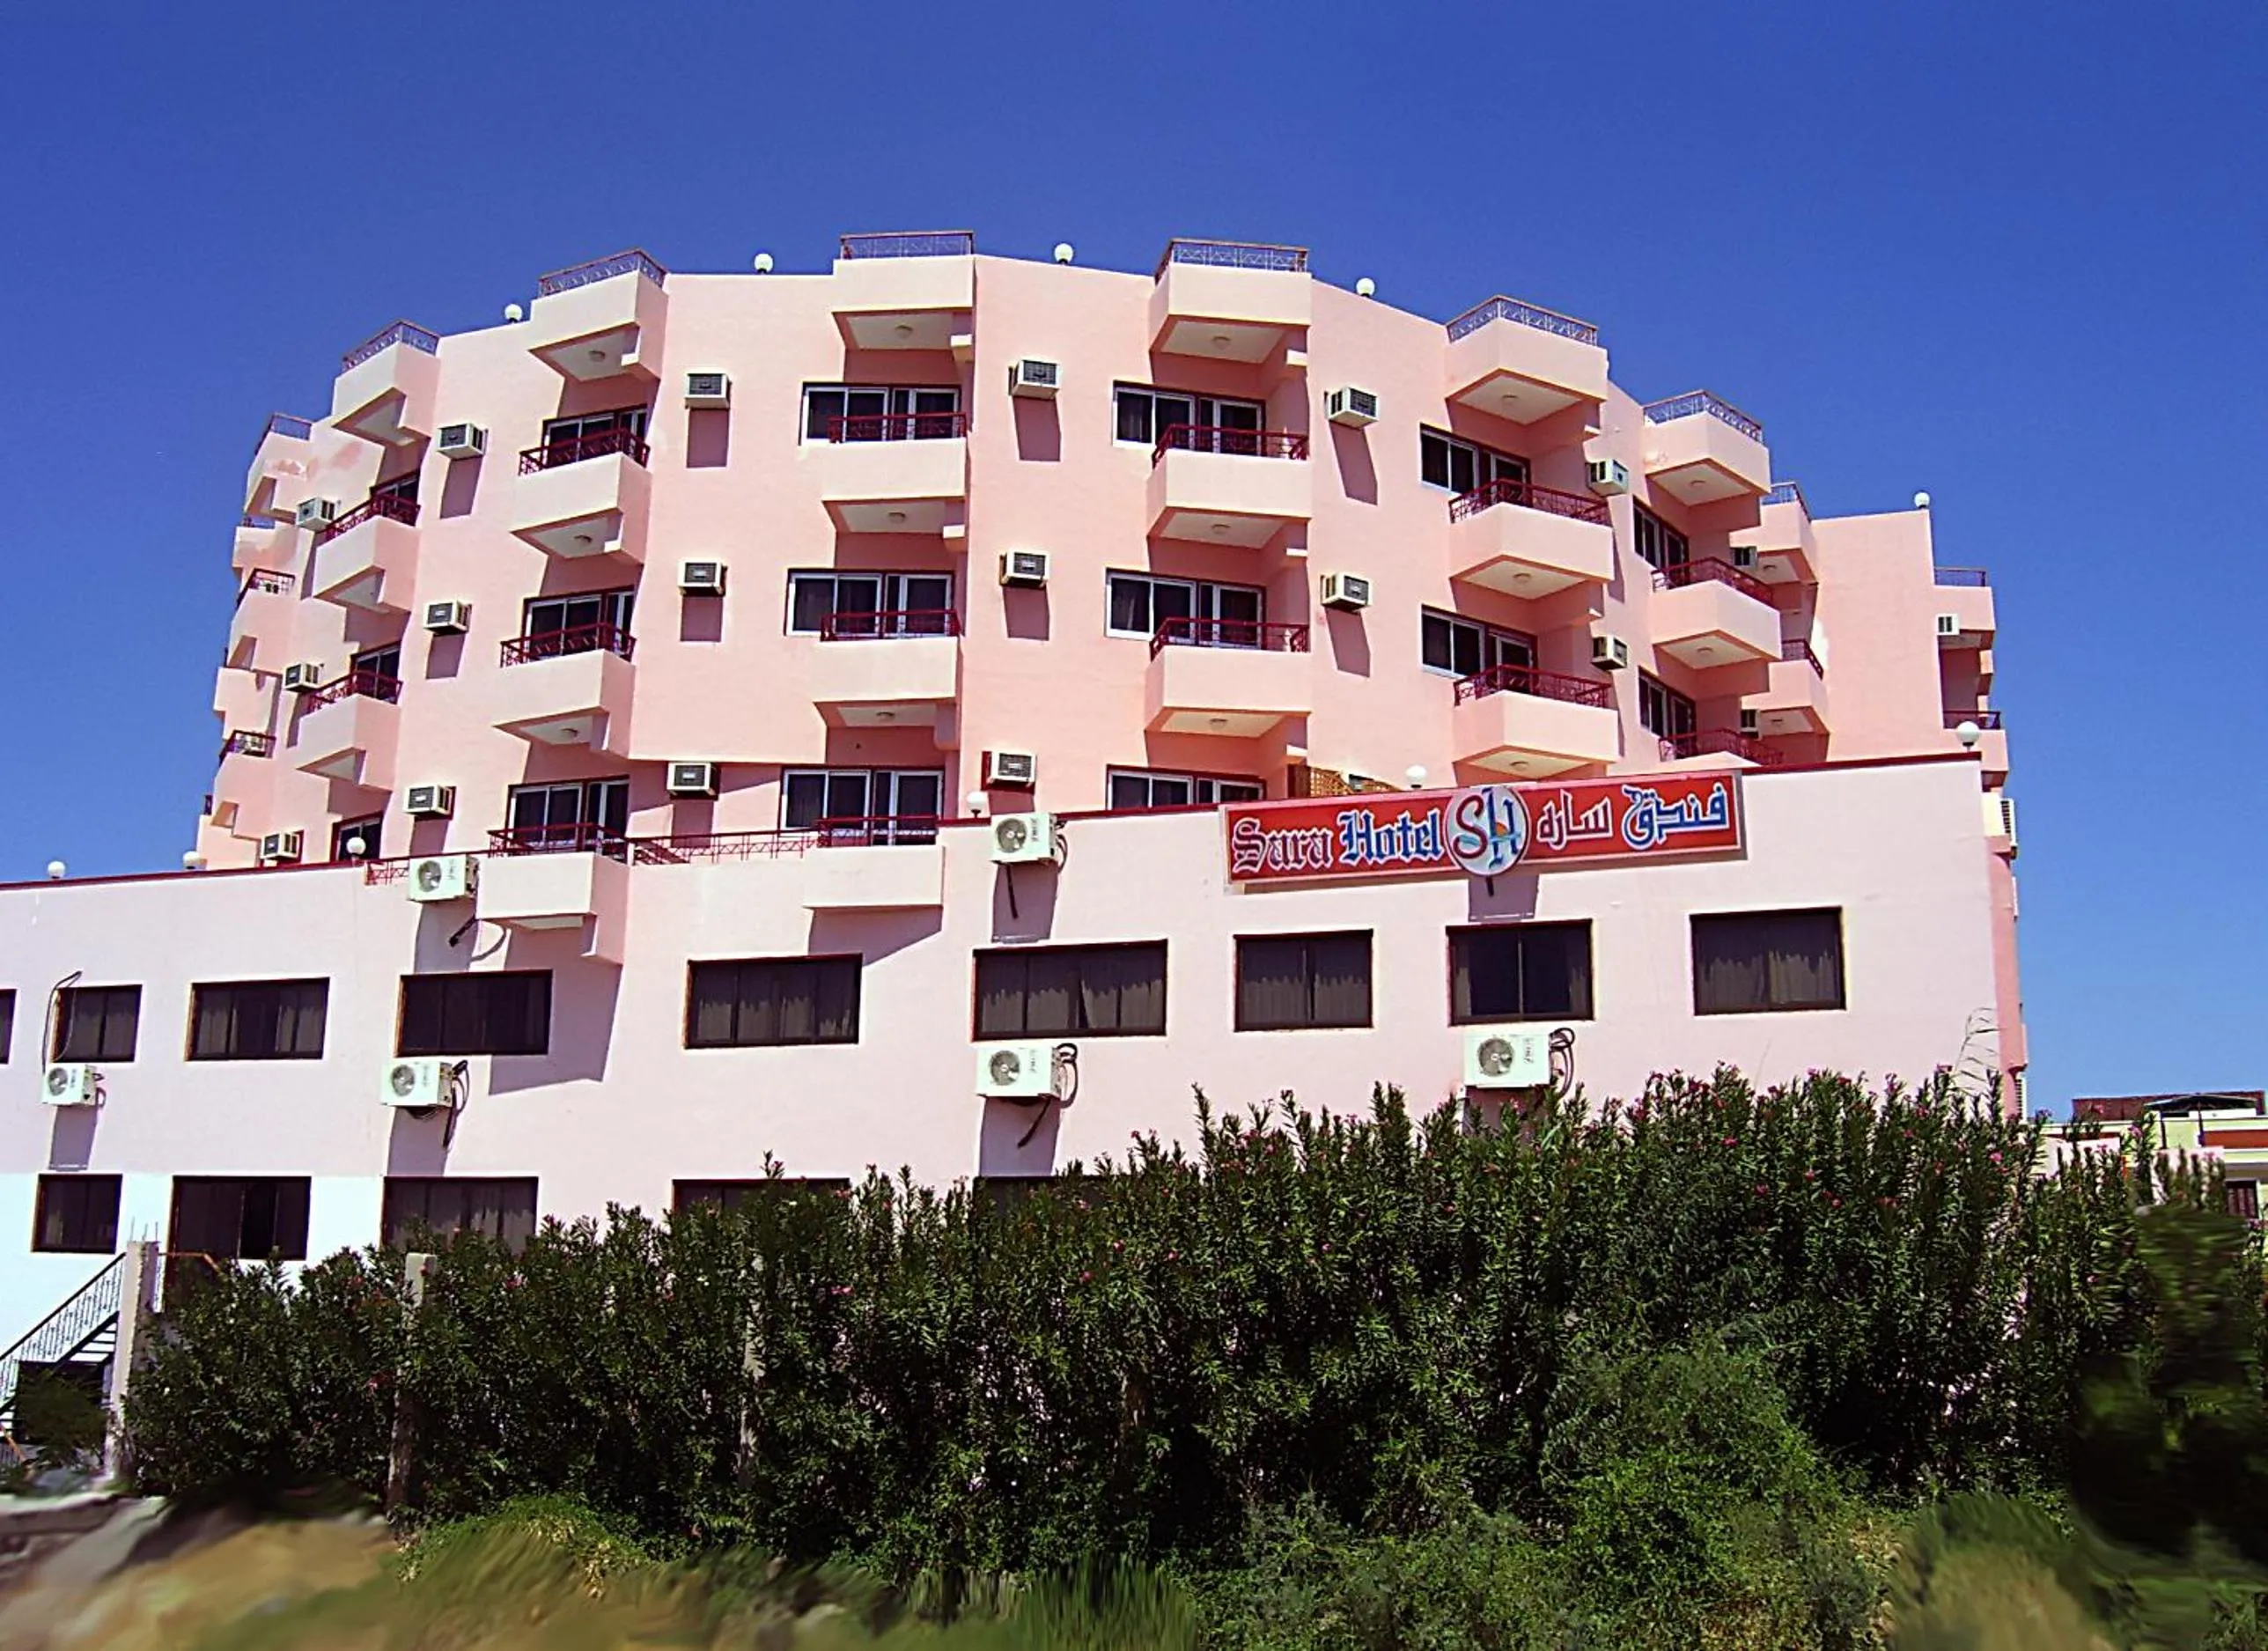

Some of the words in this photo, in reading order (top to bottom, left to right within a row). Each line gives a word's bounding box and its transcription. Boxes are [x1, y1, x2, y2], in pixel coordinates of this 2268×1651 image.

[1233, 817, 1333, 873] Sara
[1336, 807, 1445, 866] Hotel
[1453, 786, 1521, 869] SH
[1536, 788, 1613, 850] ساره
[1621, 781, 1730, 851] فندق
